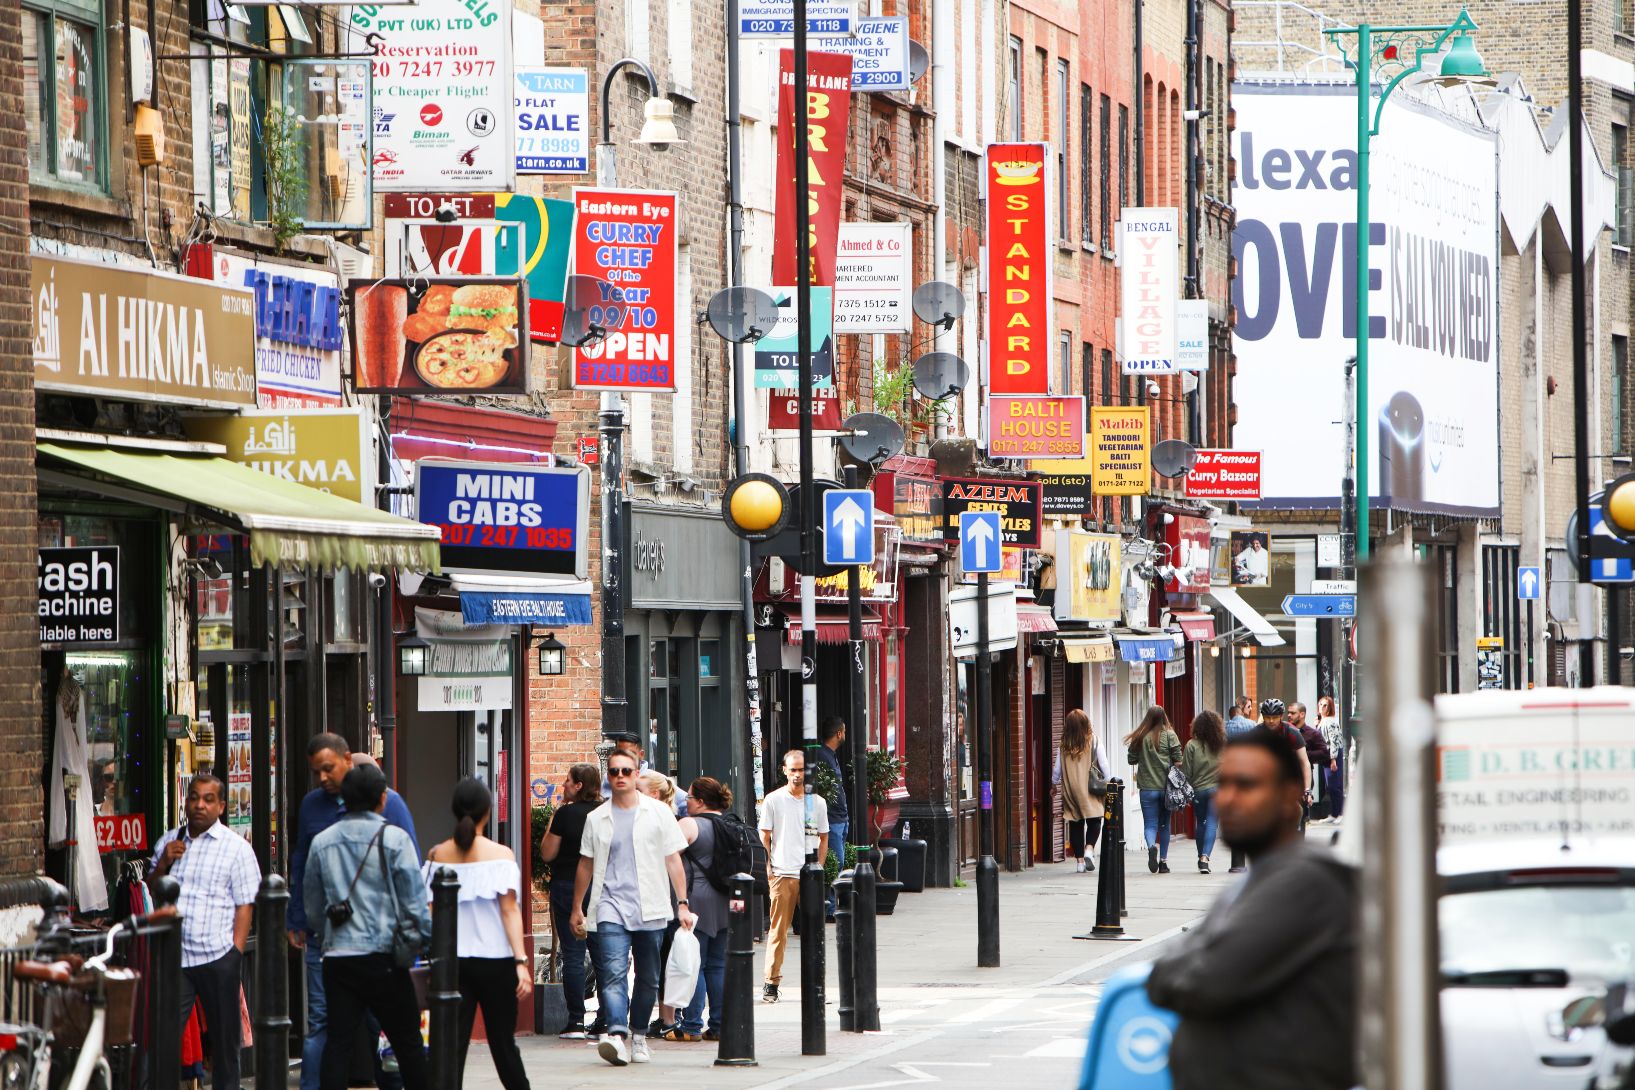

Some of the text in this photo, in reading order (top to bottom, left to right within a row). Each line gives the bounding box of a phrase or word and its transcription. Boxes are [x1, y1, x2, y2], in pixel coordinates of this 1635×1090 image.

[378, 18, 473, 32] PVT (UK) LTD
[751, 20, 840, 32] 020 735 1118
[375, 42, 478, 57] Reservation
[818, 37, 885, 47] TRAINING &
[398, 60, 443, 78] 7247
[451, 60, 495, 78] 3977
[534, 76, 575, 89] TARN
[819, 75, 848, 91] LANE
[866, 73, 898, 83] 2900
[388, 85, 441, 99] Cheaper
[446, 85, 488, 99] Flight!
[525, 98, 556, 108] FLAT
[373, 123, 390, 132] TA
[518, 113, 580, 131] SALE
[413, 130, 449, 139] Biman
[517, 137, 580, 153] 77 8989
[518, 157, 580, 169] -tarn.co.uk
[1232, 131, 1359, 191] lexa
[406, 197, 433, 217] TO
[580, 200, 670, 220] Eastern Eye
[586, 221, 663, 244] CURRY
[1126, 222, 1172, 233] BENGAL
[840, 239, 900, 251] Ahmed & Co
[596, 247, 652, 267] CHEF
[608, 270, 641, 281] Of the
[598, 281, 650, 303] Year
[1005, 194, 1032, 375] STANDARD
[1136, 236, 1163, 355] VILLAGE
[1390, 225, 1491, 363] IS ALL YOU NEED
[839, 299, 886, 308] 7375 1512
[589, 306, 658, 328] 09/10
[835, 314, 899, 323] 20 7247 5752
[117, 296, 211, 389] HIKMA
[580, 333, 669, 360] OPEN
[1179, 340, 1204, 348] SALE
[256, 347, 322, 380] FRIED CHICKEN
[771, 355, 816, 366] TO LT
[1127, 358, 1173, 370] OPEN
[212, 363, 255, 399] Islamic Shop
[591, 364, 625, 382] 7247
[628, 363, 669, 383] 8643
[774, 384, 838, 398] MATER
[787, 400, 827, 415] CEF
[1010, 401, 1065, 418] BALTI
[1000, 421, 1072, 437] HOUSE
[1102, 434, 1140, 442] TANDOORI
[992, 439, 1080, 454] 0171 247 5855
[1191, 453, 1257, 464] The Famous
[1037, 476, 1086, 485] sold (stc)
[1188, 469, 1258, 484] Curry Bazaar
[456, 473, 535, 500] MINI
[948, 483, 1033, 504] AZEEM
[1188, 487, 1259, 496] Vegetarian Specialist
[448, 500, 542, 527] CABS
[967, 501, 1008, 515] GENTS
[1001, 517, 1031, 531] YLES
[481, 525, 519, 547] 247
[526, 527, 573, 549] 1035
[38, 551, 113, 590] ash
[492, 599, 520, 616] EASTERN
[547, 600, 566, 617] HOUSE
[80, 625, 112, 641] here
[1498, 787, 1629, 806] ENGINEERING
[96, 820, 142, 846] £2.00
